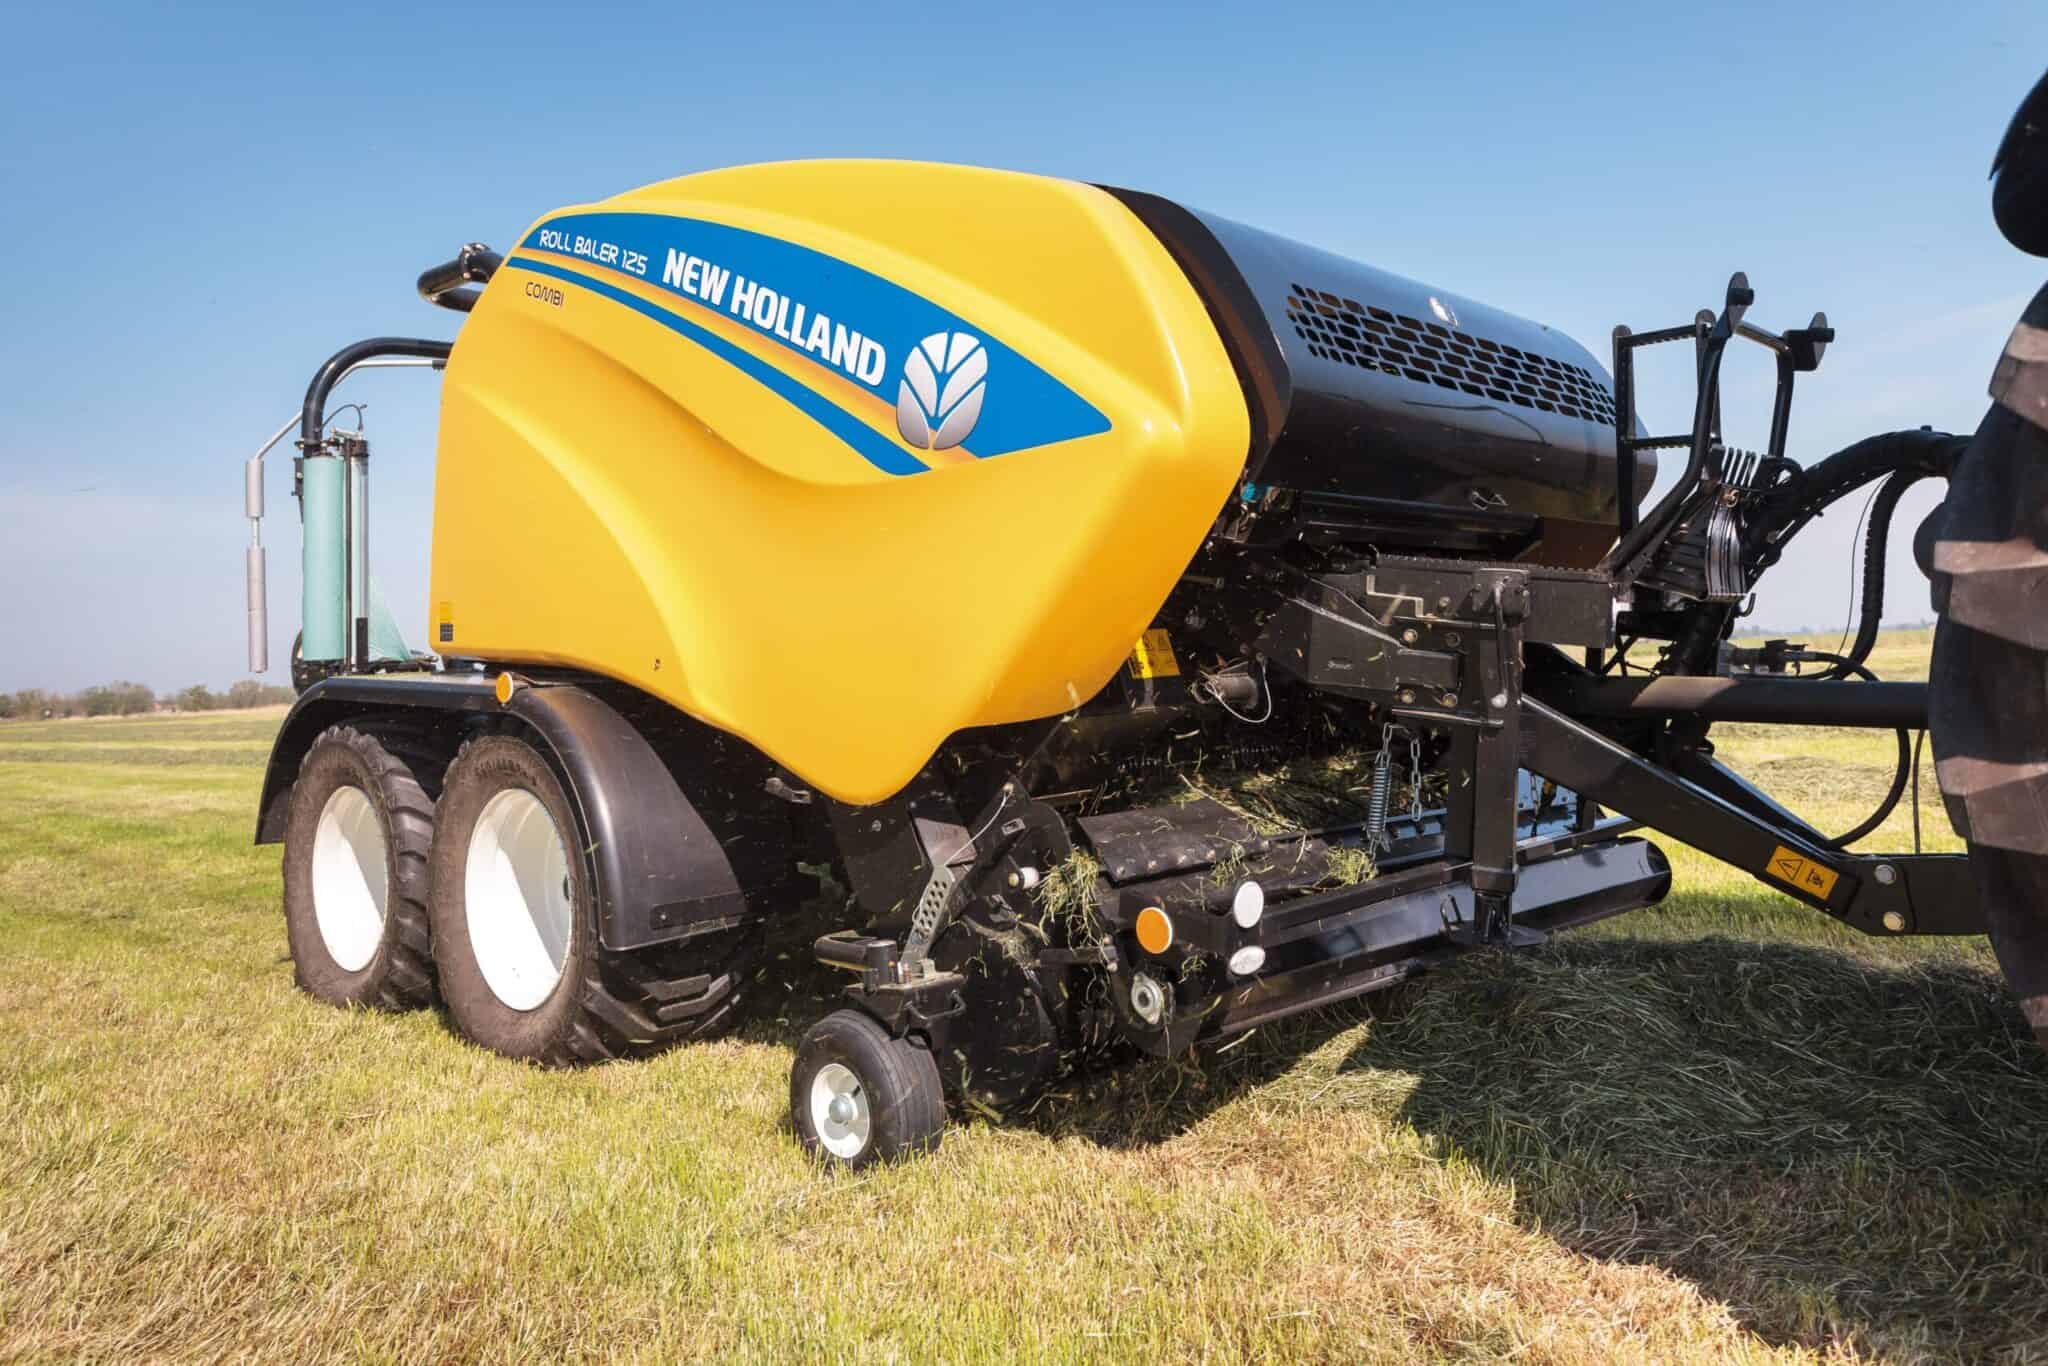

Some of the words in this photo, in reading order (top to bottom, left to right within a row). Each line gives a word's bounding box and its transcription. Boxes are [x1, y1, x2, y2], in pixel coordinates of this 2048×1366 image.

[539, 229, 571, 252] ROLL
[574, 235, 619, 265] BALER
[621, 249, 648, 276] 125
[525, 281, 565, 306] COMBI
[662, 248, 731, 306] NEW
[730, 275, 887, 387] HOLLAND
